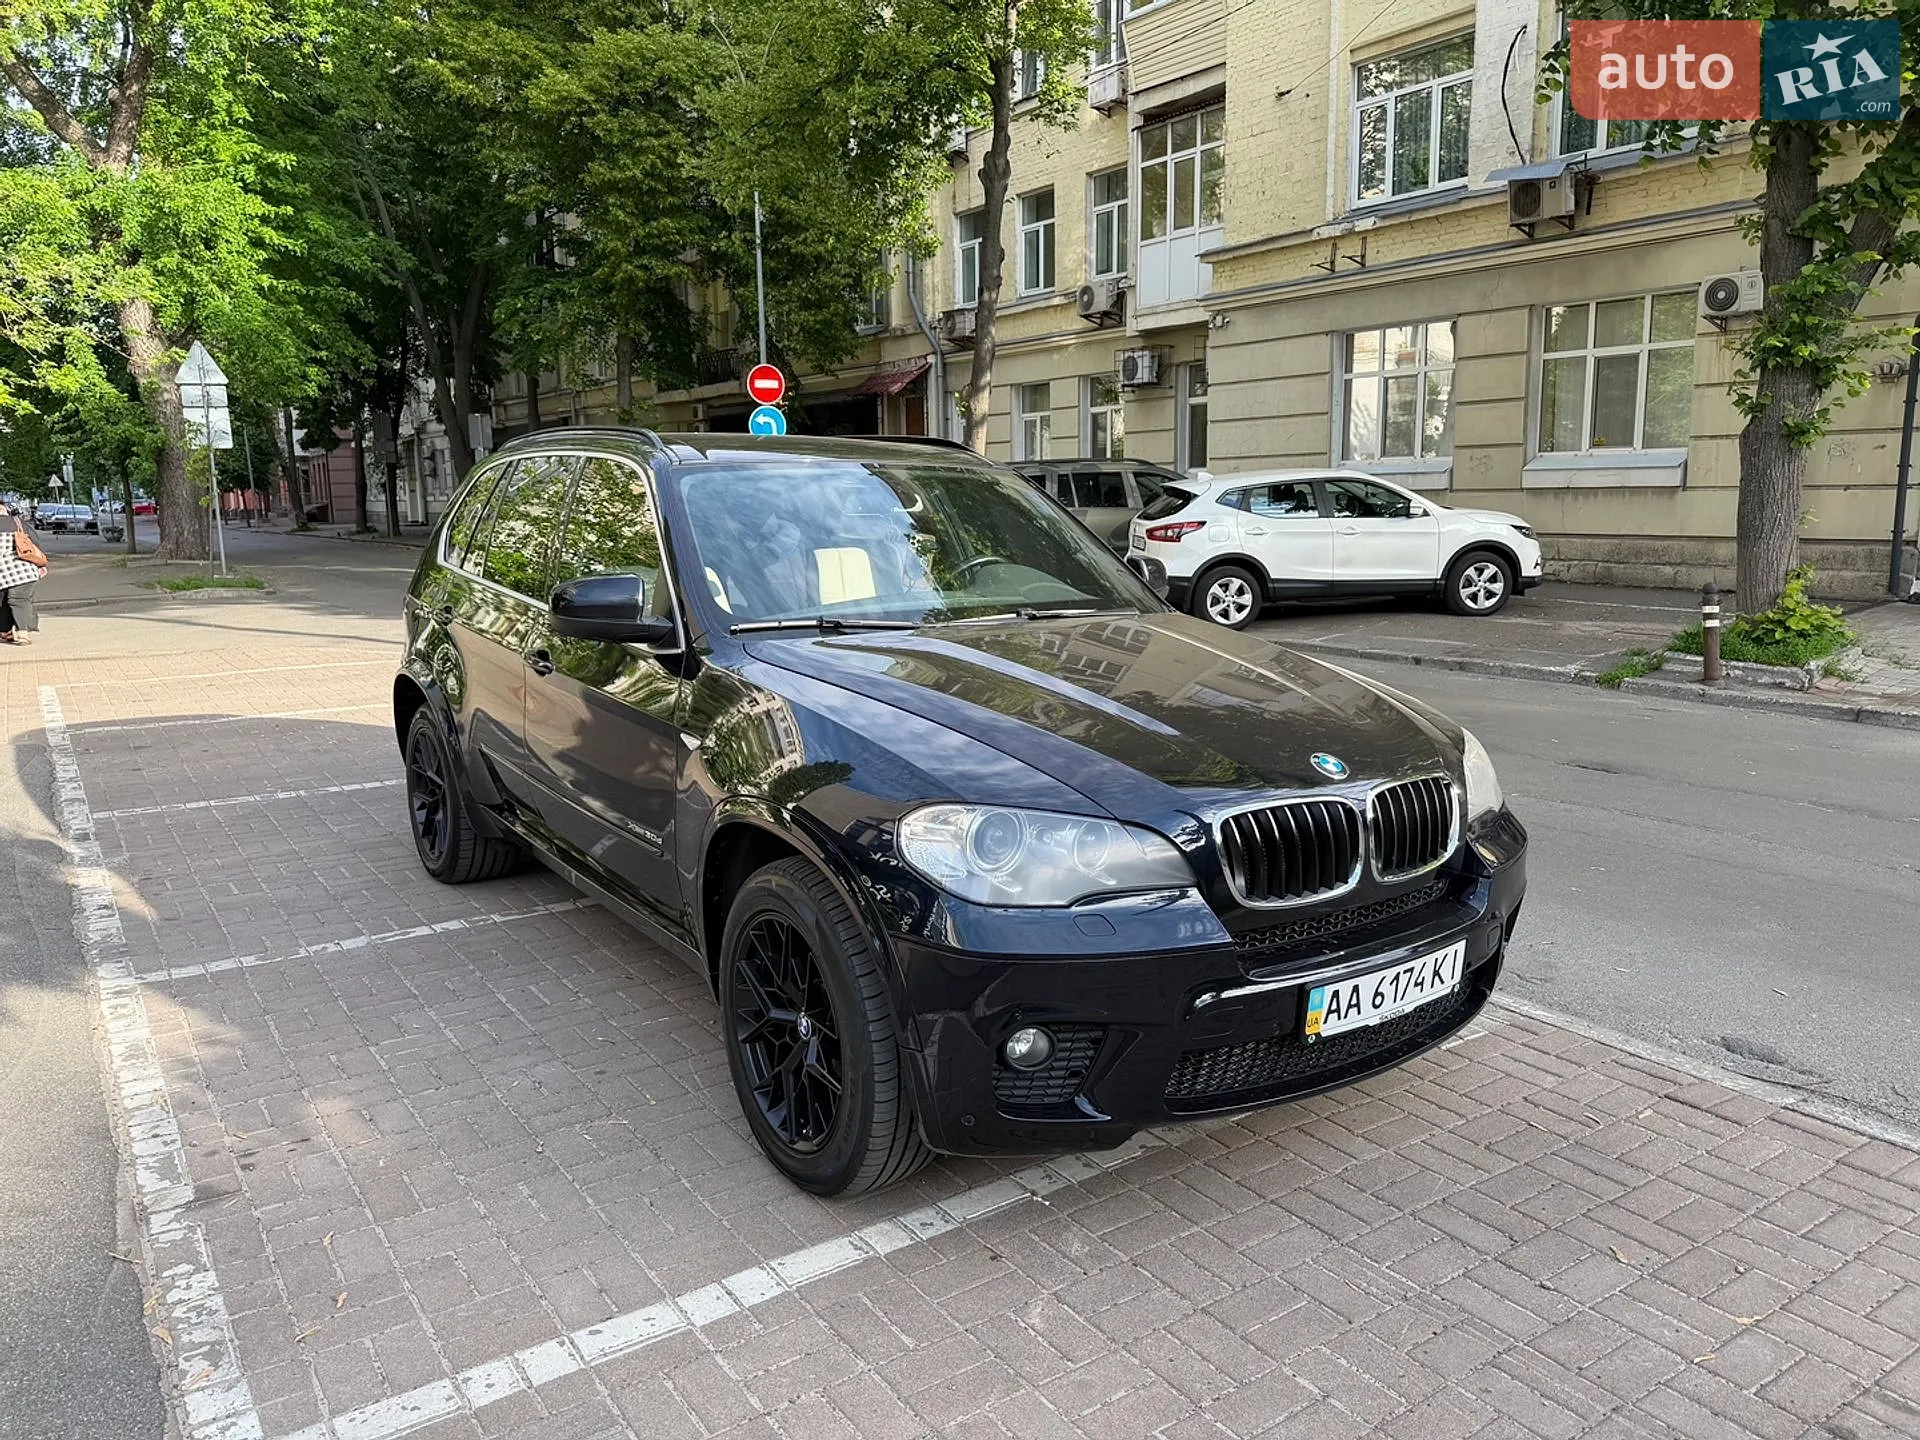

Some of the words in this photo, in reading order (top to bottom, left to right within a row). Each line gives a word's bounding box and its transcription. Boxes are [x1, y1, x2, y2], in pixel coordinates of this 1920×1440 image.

[1323, 984, 1361, 1025] AA
[1372, 961, 1427, 1010] 6174
[1431, 949, 1459, 989] KI
[1307, 1017, 1319, 1028] UA
